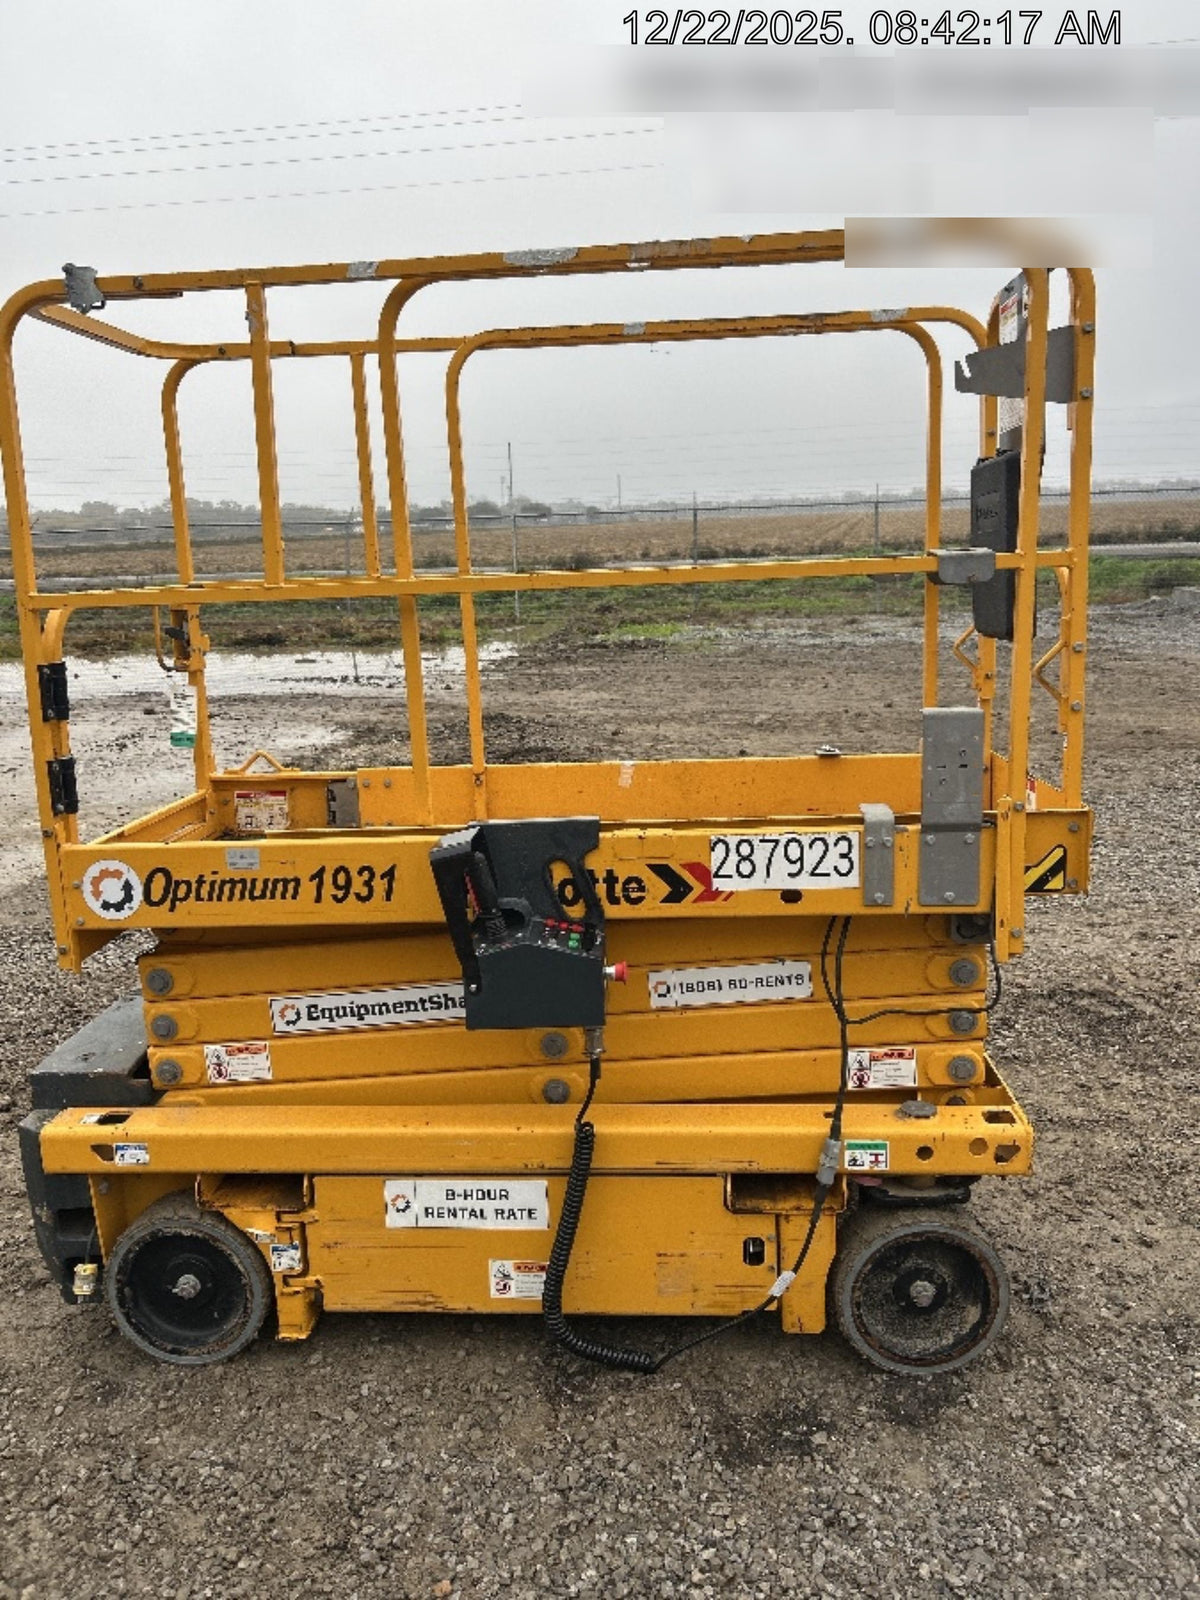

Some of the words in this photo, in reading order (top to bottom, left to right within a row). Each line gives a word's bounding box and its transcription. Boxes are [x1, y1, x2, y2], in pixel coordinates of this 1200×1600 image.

[711, 835, 854, 879] 287923
[143, 867, 301, 912] Optimum
[309, 864, 398, 904] 1931
[424, 1206, 488, 1220] RENTAL
[495, 1208, 538, 1221] RATE
